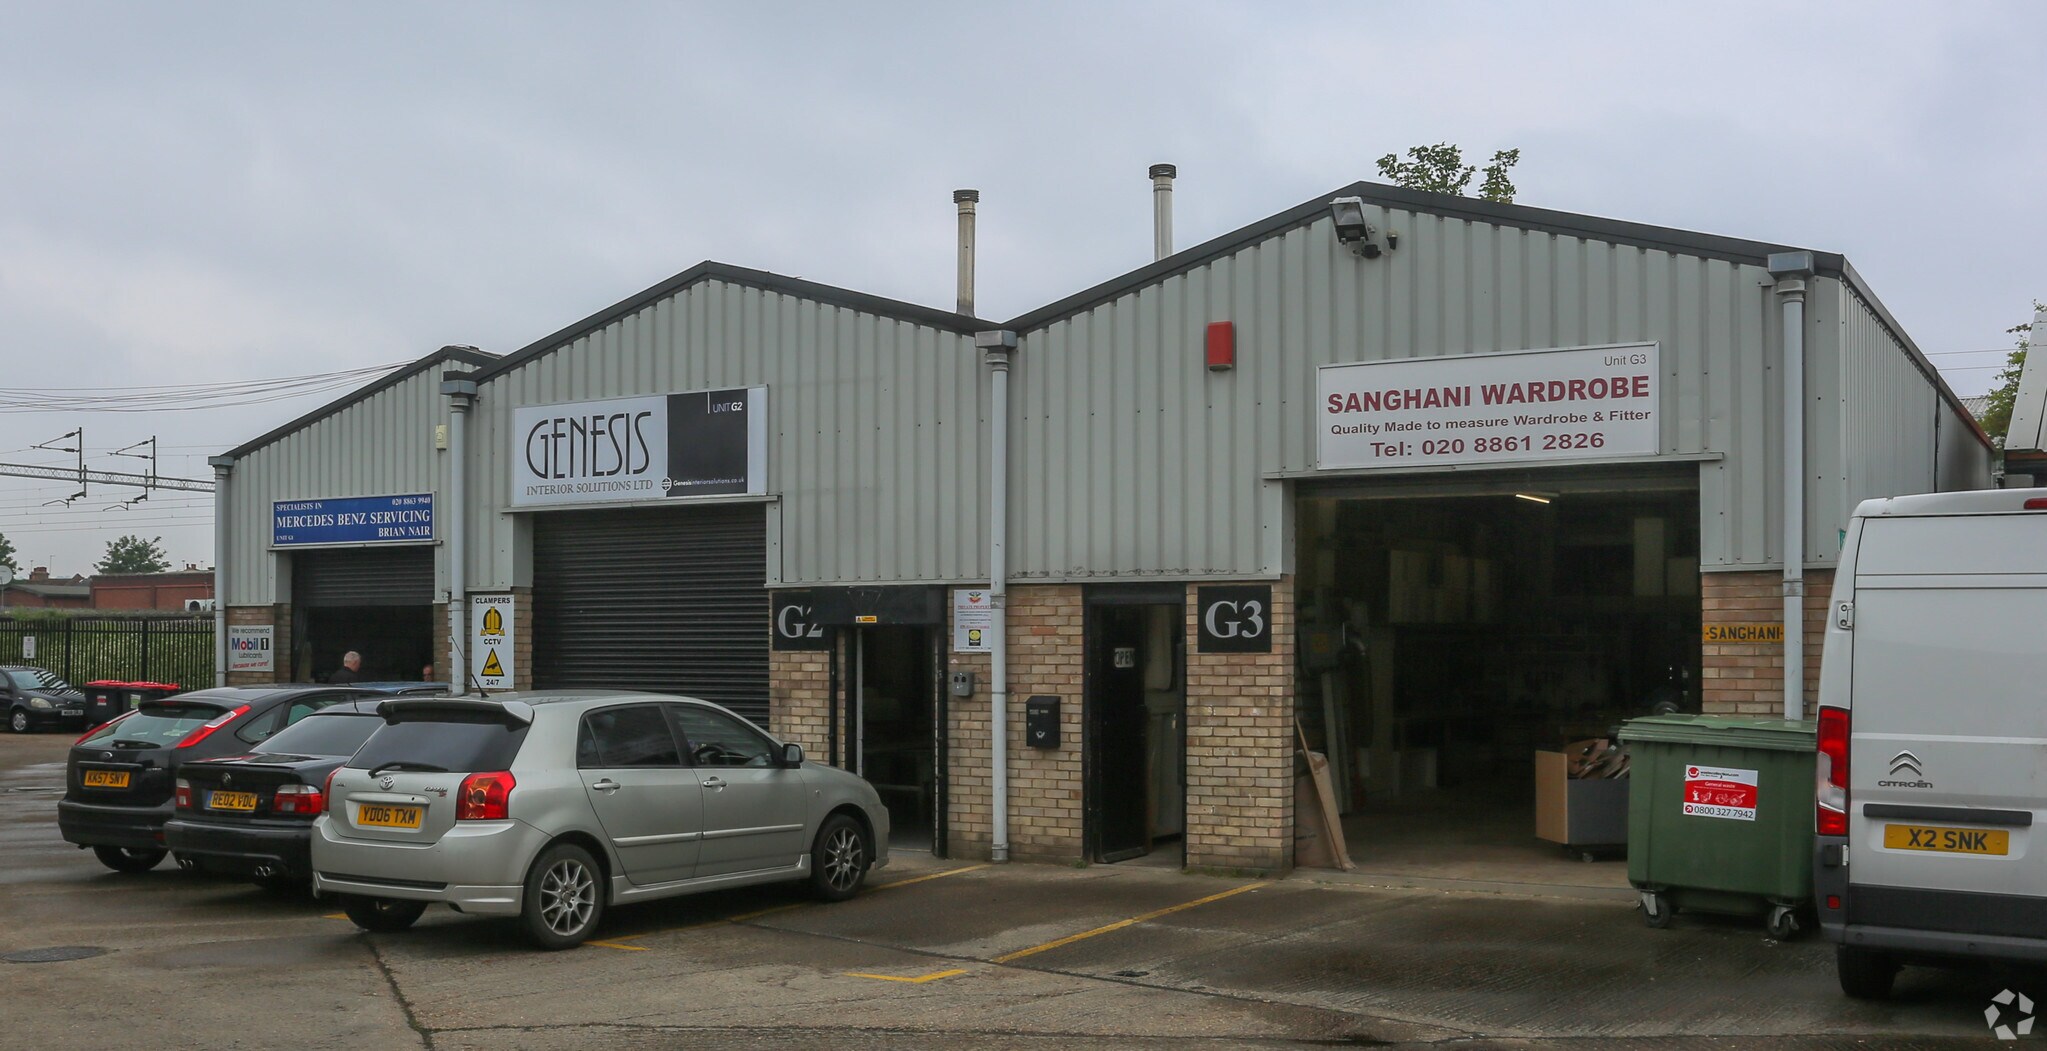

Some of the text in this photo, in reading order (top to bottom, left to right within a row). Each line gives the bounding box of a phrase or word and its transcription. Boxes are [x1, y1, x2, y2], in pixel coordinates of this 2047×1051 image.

[1604, 354, 1647, 367] Unit G3
[1327, 375, 1649, 414] SANGHANI WARDROBE
[712, 401, 743, 413] UNIT G2
[1331, 410, 1651, 435] Quality Made to measure Wardrobe & Fitter
[526, 411, 652, 480] GENESIS
[1370, 432, 1604, 457] Tel: 020 8861 2826
[526, 479, 653, 496] INTERIOR SOLUTIONS LTD
[276, 503, 313, 511] SPECIALISTS
[391, 498, 402, 506] 020
[276, 510, 430, 528] MERCEDES BENZ SERVICING
[378, 525, 430, 537] BRIAN NAIR
[1205, 600, 1264, 638] G3
[1709, 627, 1779, 639] SANGHANI
[231, 637, 268, 650] Mobil 1
[212, 792, 235, 807] RE02
[363, 806, 390, 822] YD06
[1694, 806, 1753, 818] 0800 327 7942
[1908, 828, 1987, 851] X2 SNK
